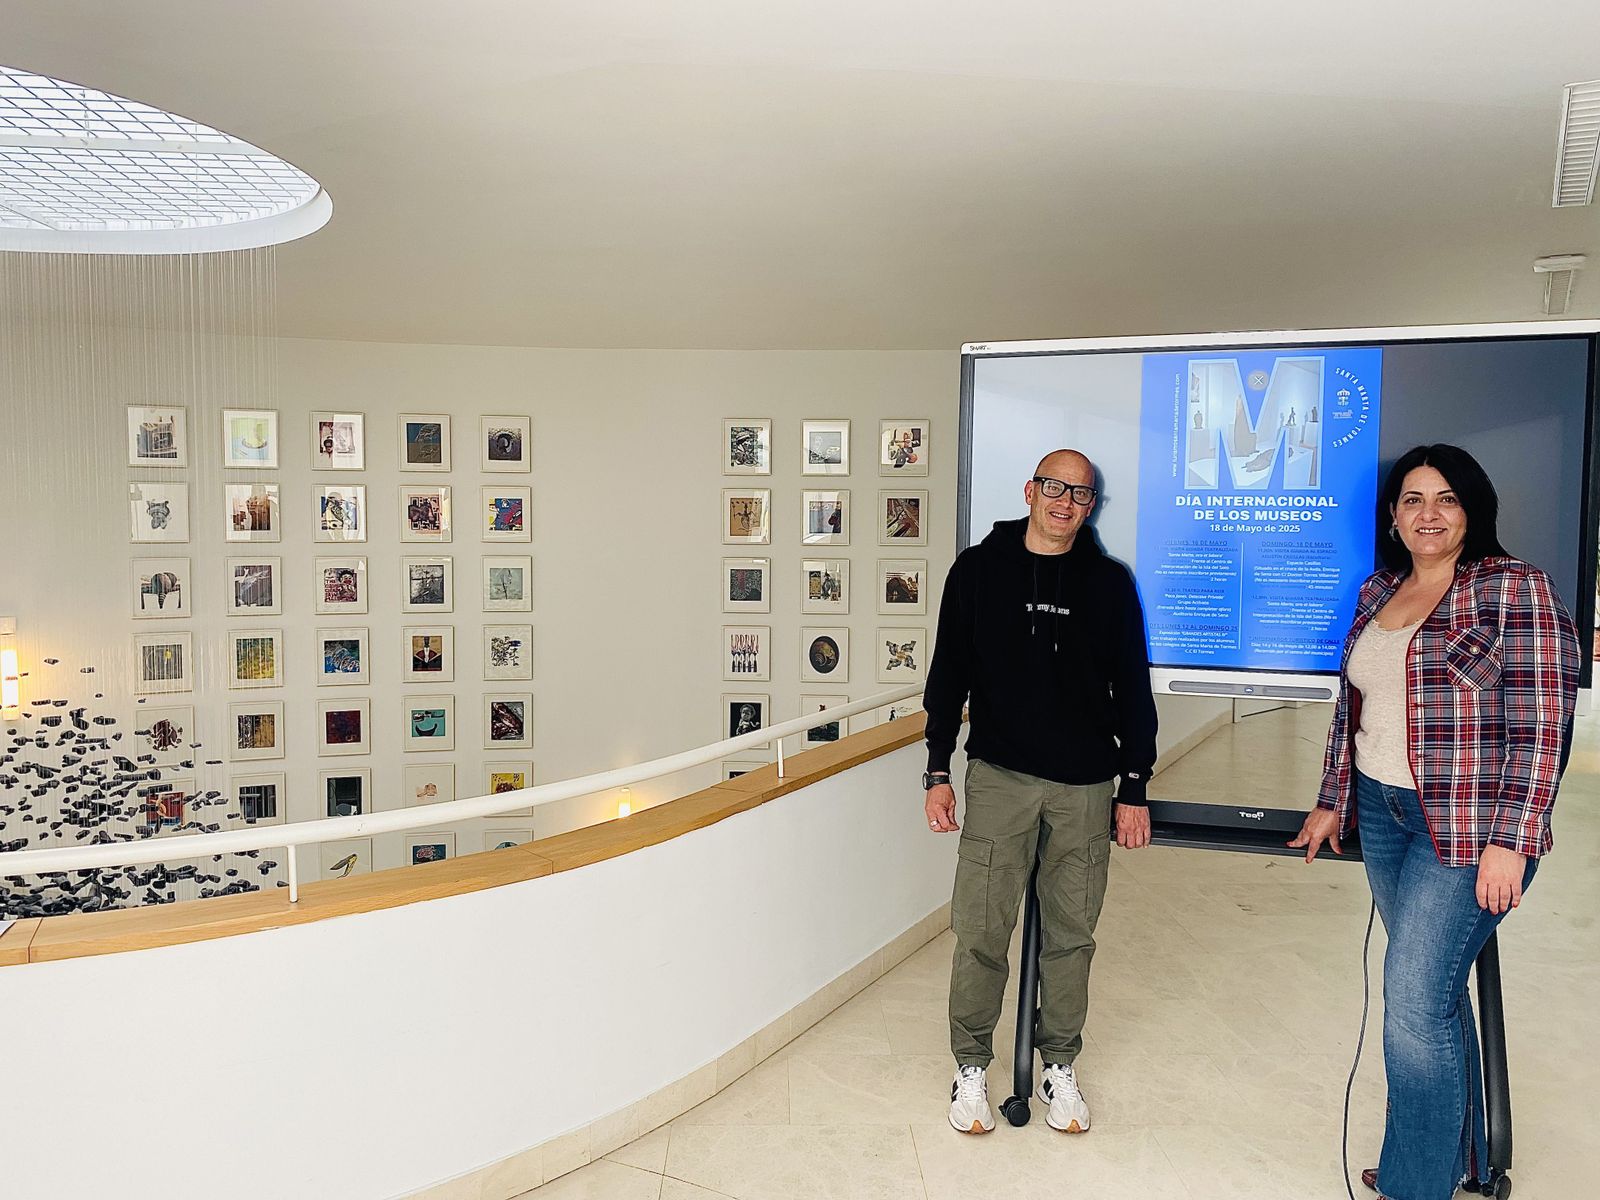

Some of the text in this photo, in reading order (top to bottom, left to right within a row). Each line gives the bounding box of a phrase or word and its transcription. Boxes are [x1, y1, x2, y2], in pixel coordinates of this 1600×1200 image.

[1335, 367, 1359, 385] SANTA
[1357, 385, 1369, 411] MARTA
[1359, 414, 1368, 424] DE
[1332, 426, 1362, 448] TORMES
[1175, 493, 1338, 507] DÍA INTERNACIONAL
[1194, 510, 1323, 521] DE LOS MUSEOS
[1209, 523, 1301, 534] 18 de Mayo de 2025
